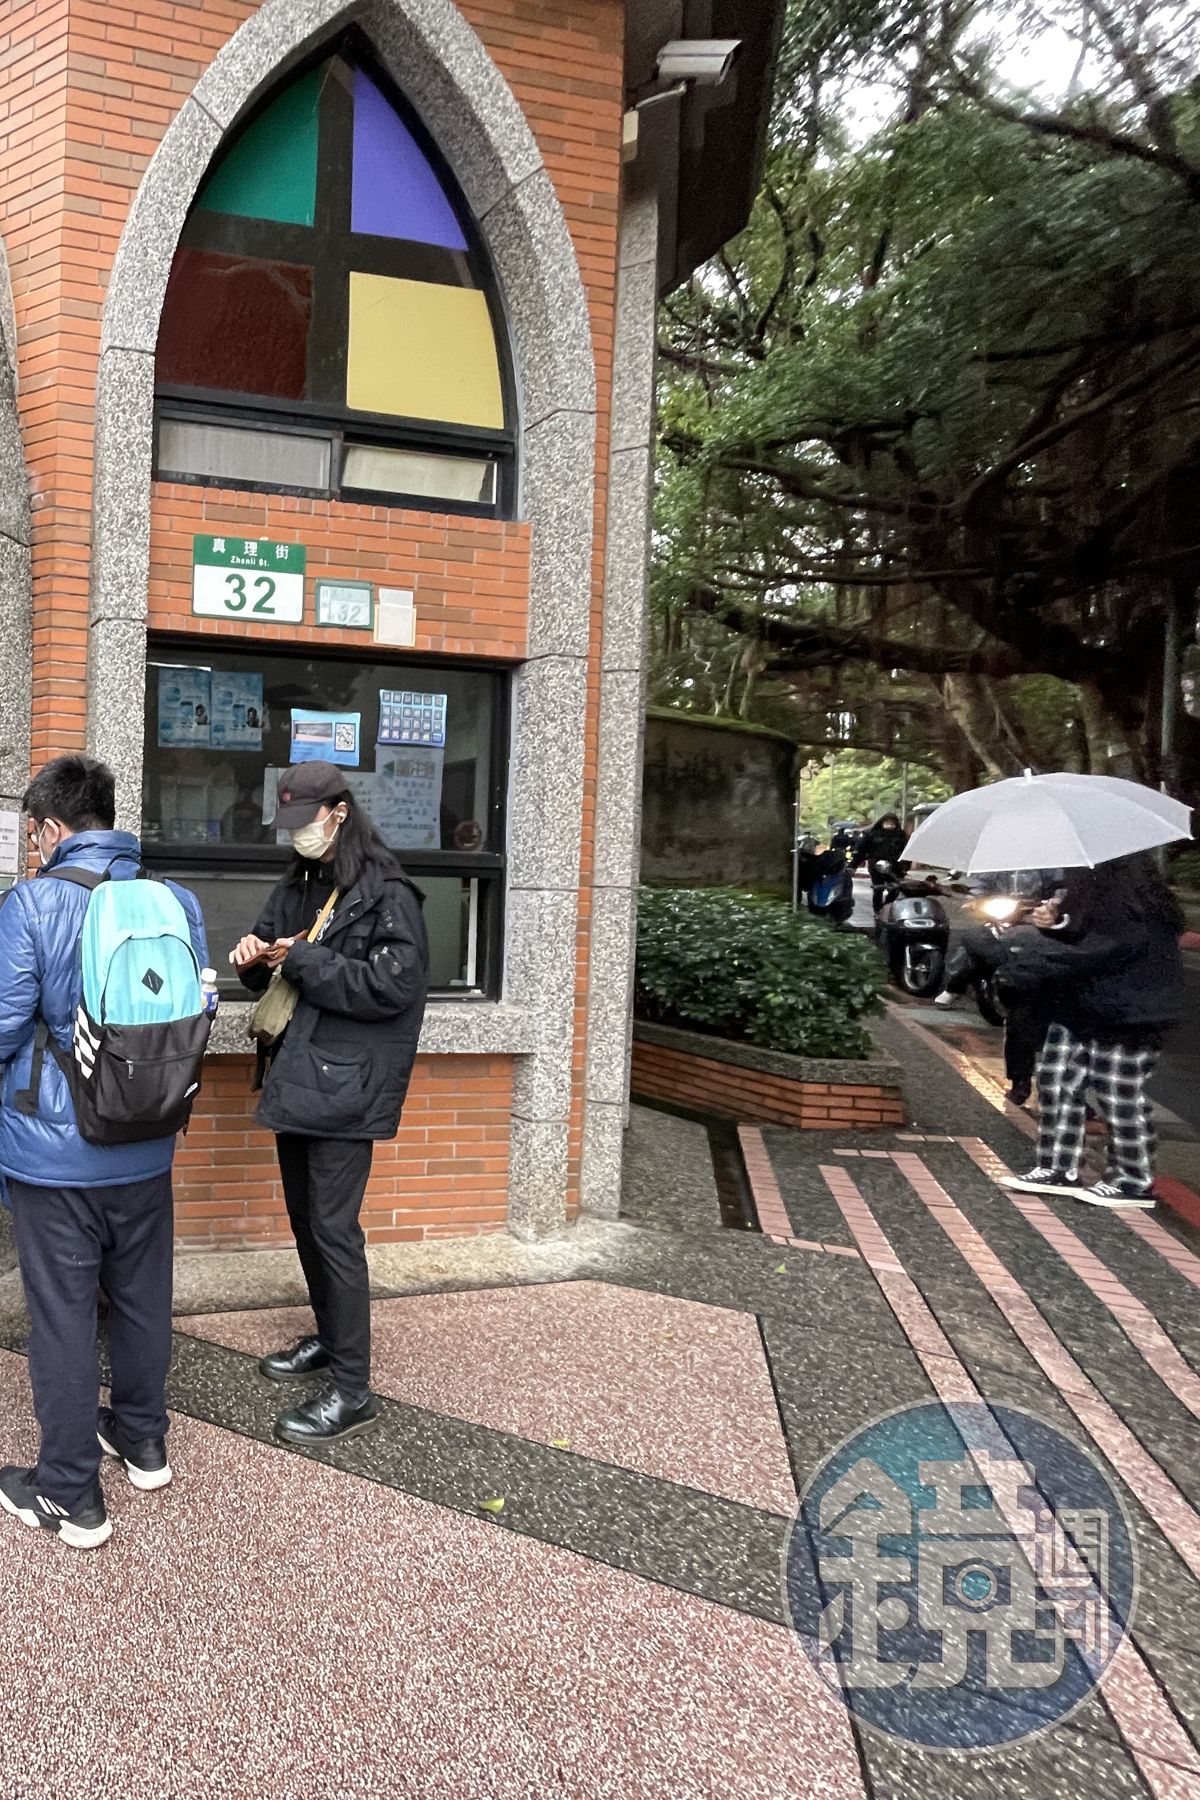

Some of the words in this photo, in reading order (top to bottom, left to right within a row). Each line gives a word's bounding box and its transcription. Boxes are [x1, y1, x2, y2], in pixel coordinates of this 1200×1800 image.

[212, 538, 289, 560] 真理街
[230, 555, 256, 566] Zhenli
[258, 558, 270, 567] St.
[224, 574, 275, 613] 32
[337, 603, 362, 623] 32
